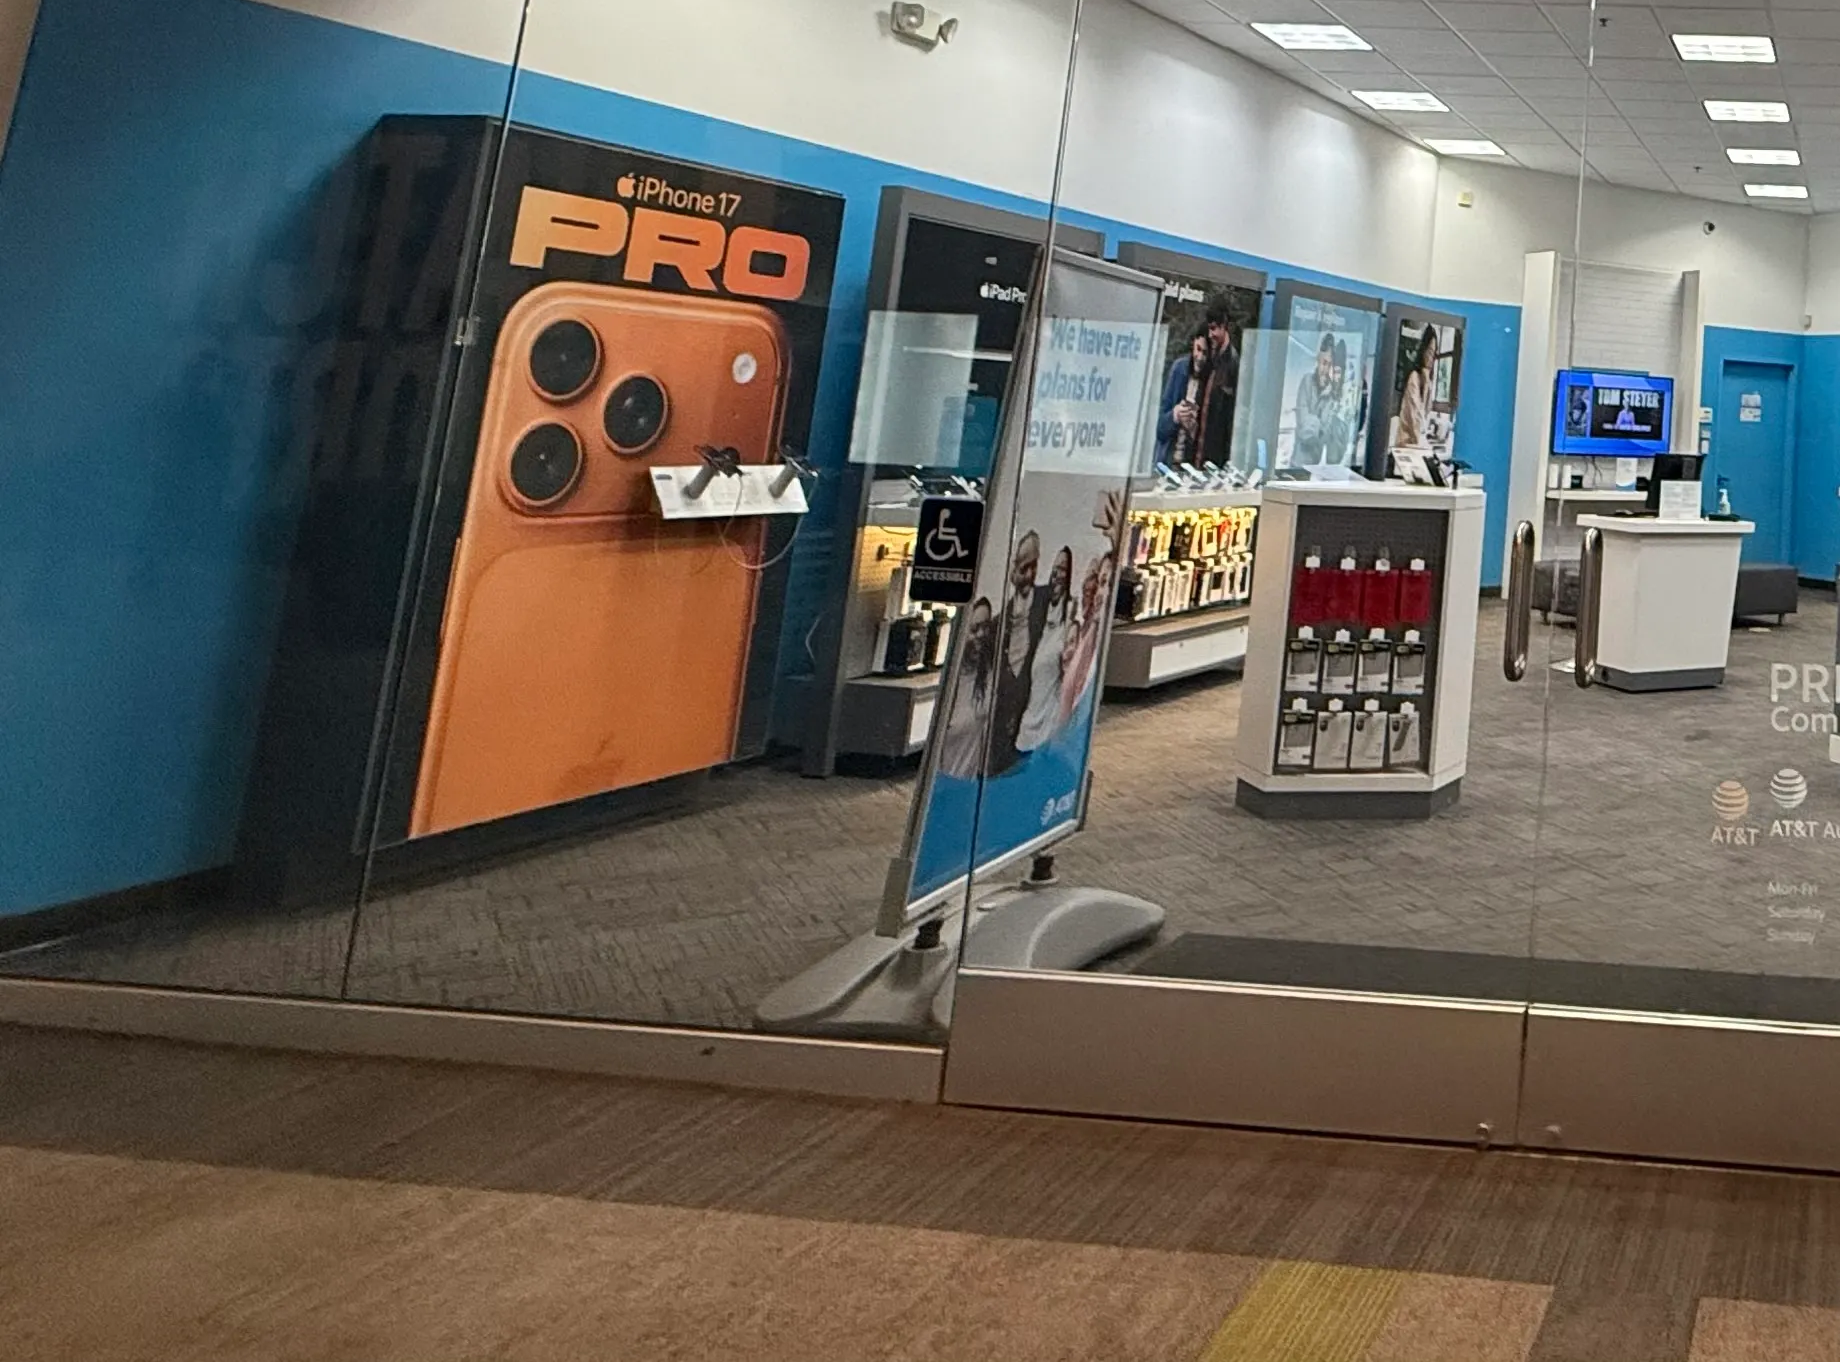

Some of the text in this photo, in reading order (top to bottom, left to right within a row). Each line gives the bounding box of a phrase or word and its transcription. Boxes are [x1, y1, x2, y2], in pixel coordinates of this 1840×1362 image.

[636, 176, 742, 217] iPhone 17
[510, 186, 810, 300] PRO
[989, 283, 1011, 302] iPad
[1051, 316, 1142, 361] We have rate
[1037, 362, 1112, 406] plans for
[1028, 417, 1106, 457] everyone
[914, 569, 973, 584] ACCESSIBLE
[1711, 826, 1760, 847] AT&T
[1770, 820, 1819, 838] AT&T
